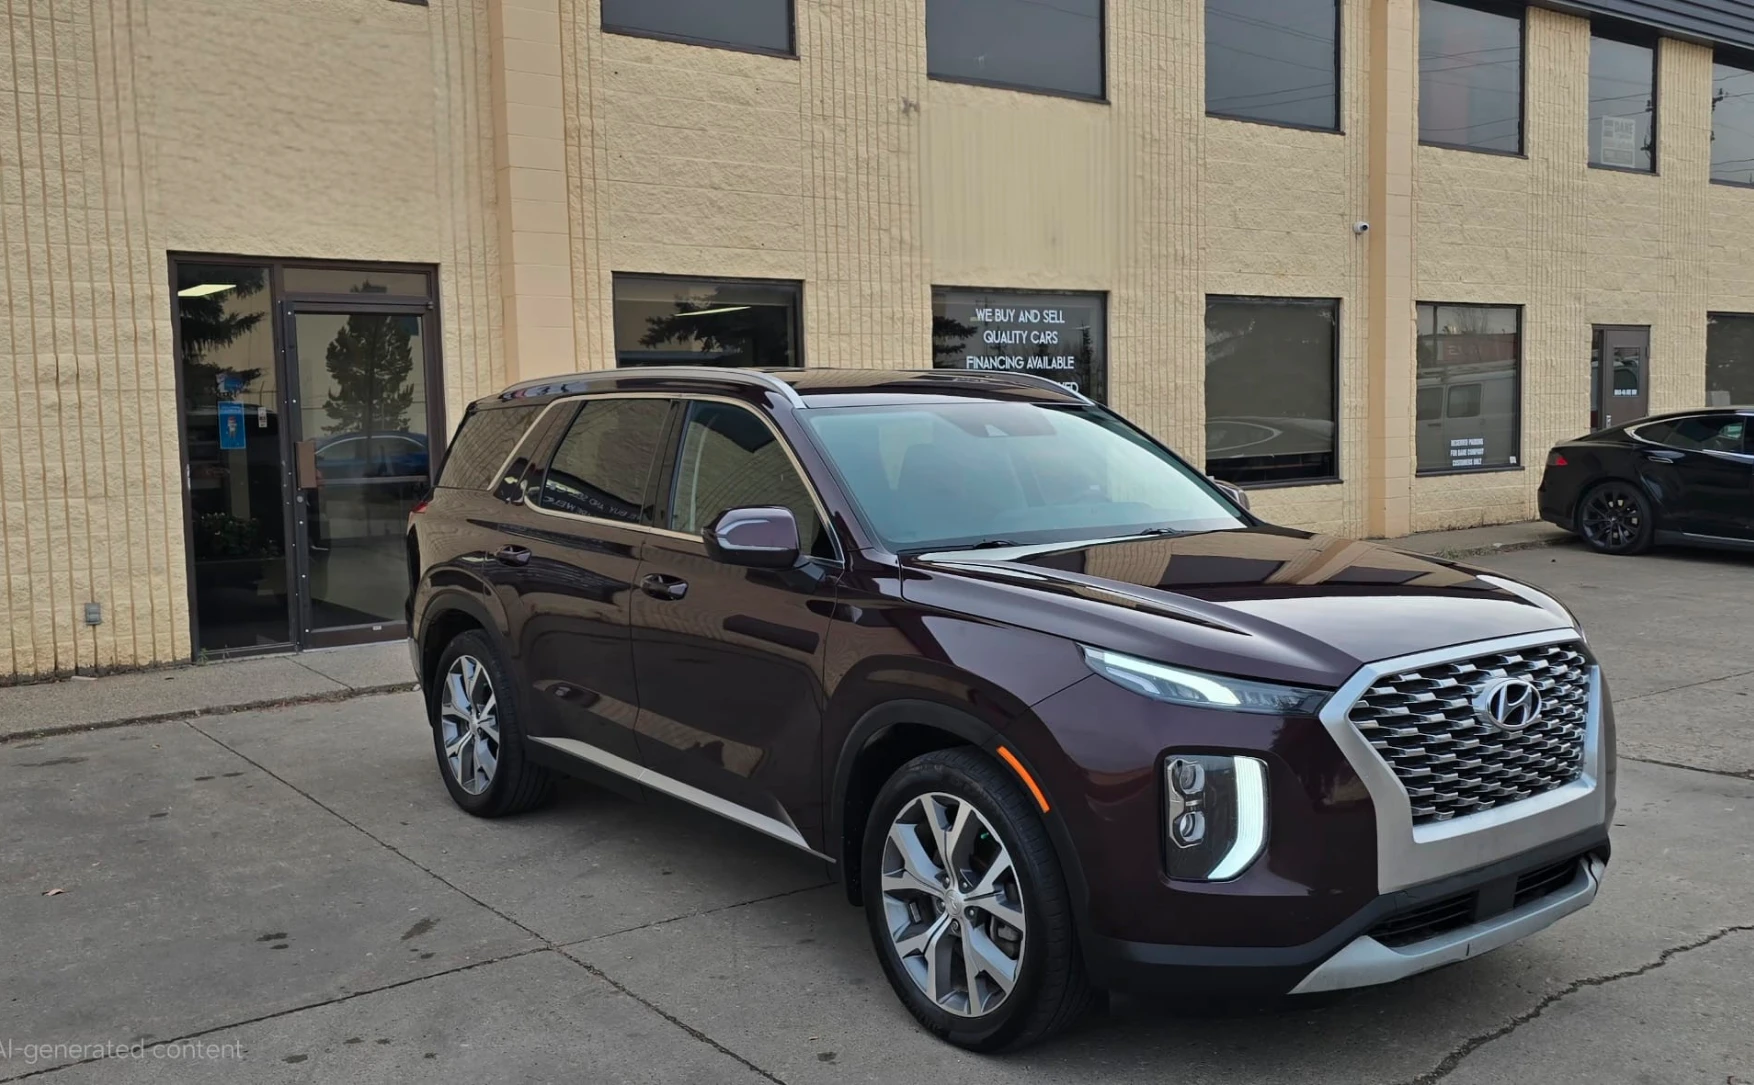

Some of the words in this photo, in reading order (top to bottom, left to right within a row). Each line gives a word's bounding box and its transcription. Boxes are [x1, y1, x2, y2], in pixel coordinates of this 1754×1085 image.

[975, 308, 993, 322] WE
[995, 308, 1016, 322] BUY
[1019, 309, 1041, 323] AND
[1043, 310, 1065, 323] SELL
[983, 330, 1028, 344] QUALITY
[1030, 330, 1058, 344] CARS
[966, 356, 1024, 370] FINANCING
[1026, 356, 1075, 370] AVAILABLE
